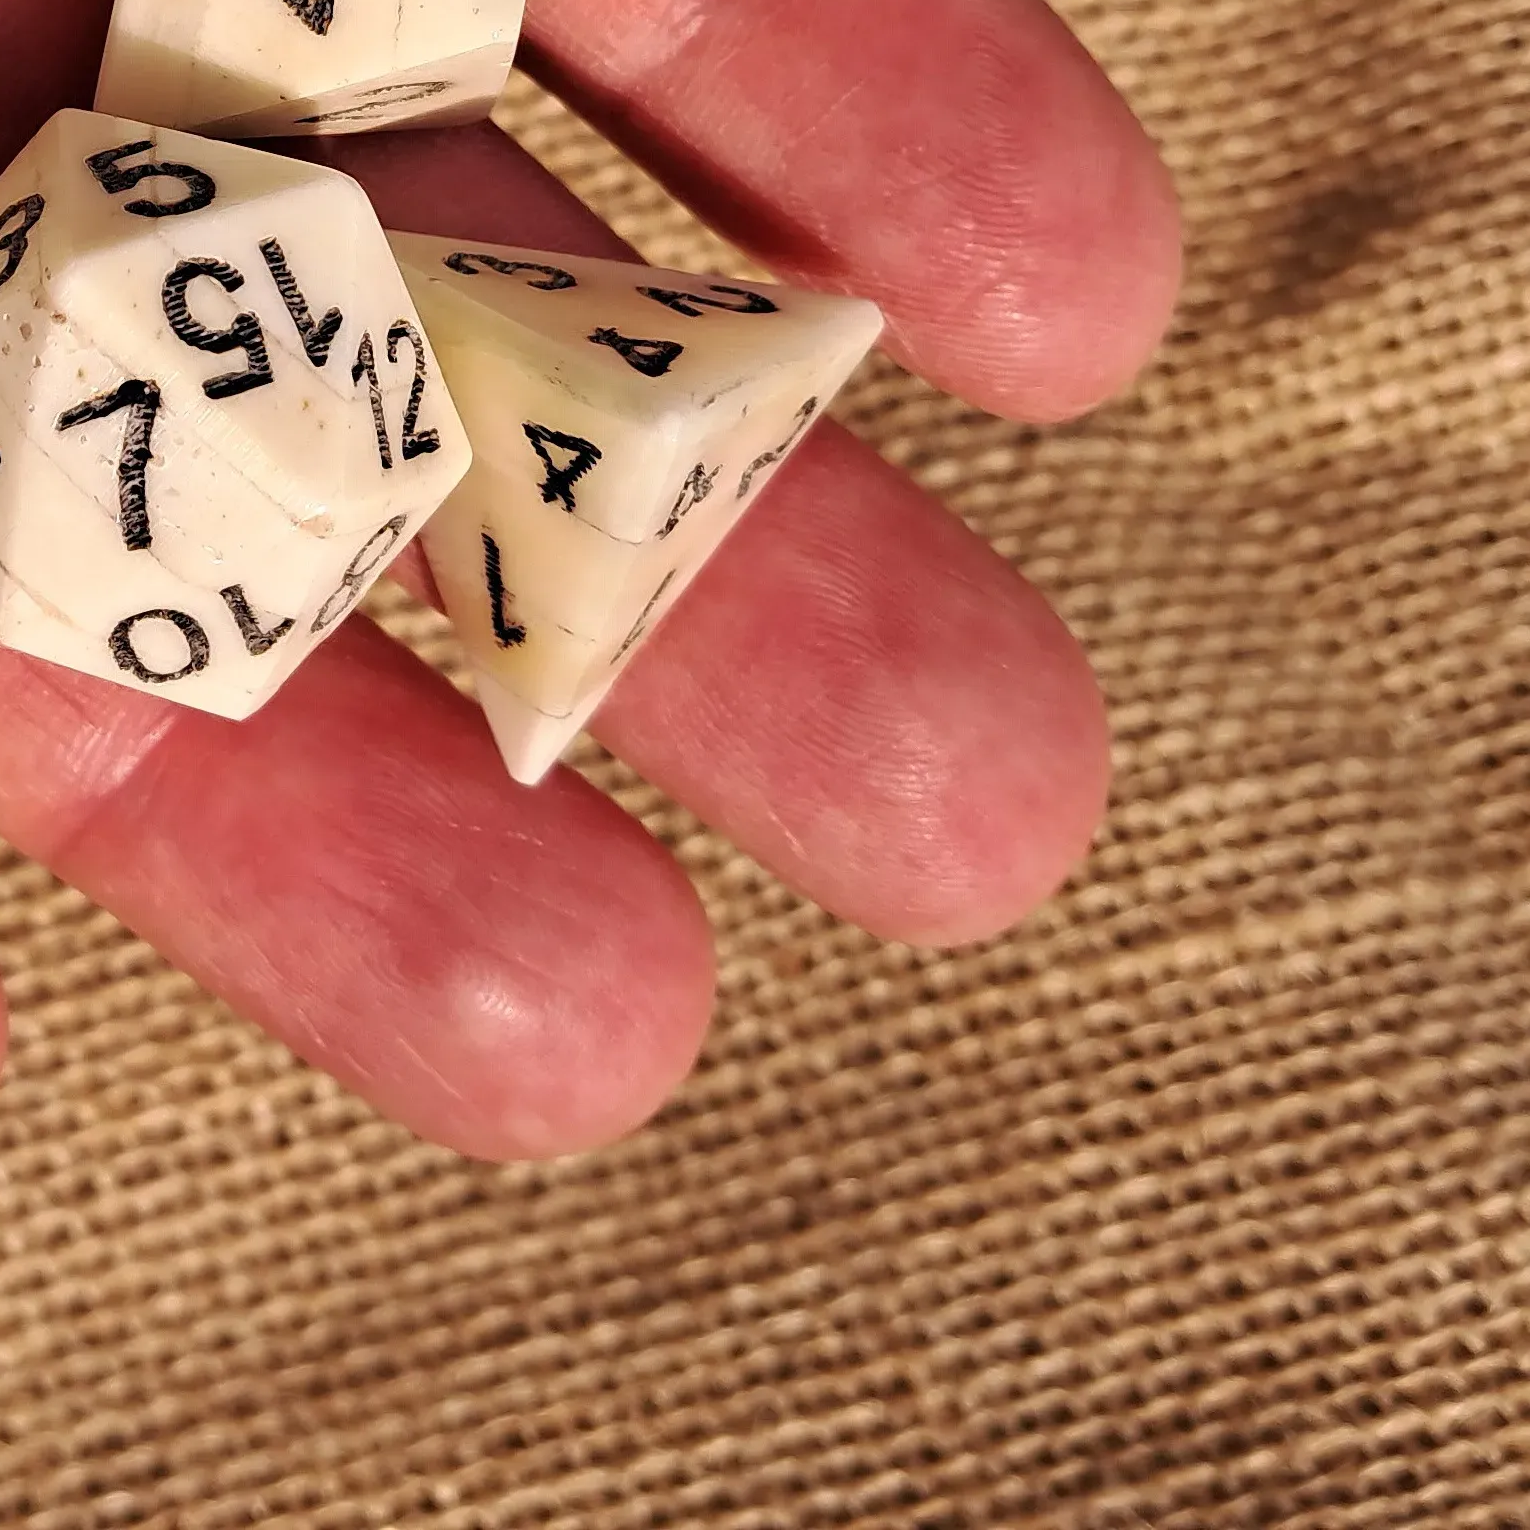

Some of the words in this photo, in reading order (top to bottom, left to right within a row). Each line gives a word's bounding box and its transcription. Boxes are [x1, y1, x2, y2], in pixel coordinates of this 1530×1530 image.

[85, 140, 217, 217] 5
[162, 235, 343, 400] 15
[442, 252, 577, 290] 3
[352, 318, 442, 469] 12
[586, 326, 684, 377] 4
[54, 378, 161, 550] 7
[521, 420, 603, 513] 4
[310, 513, 408, 633] 8
[481, 530, 527, 650] 1
[109, 583, 297, 683] 10
